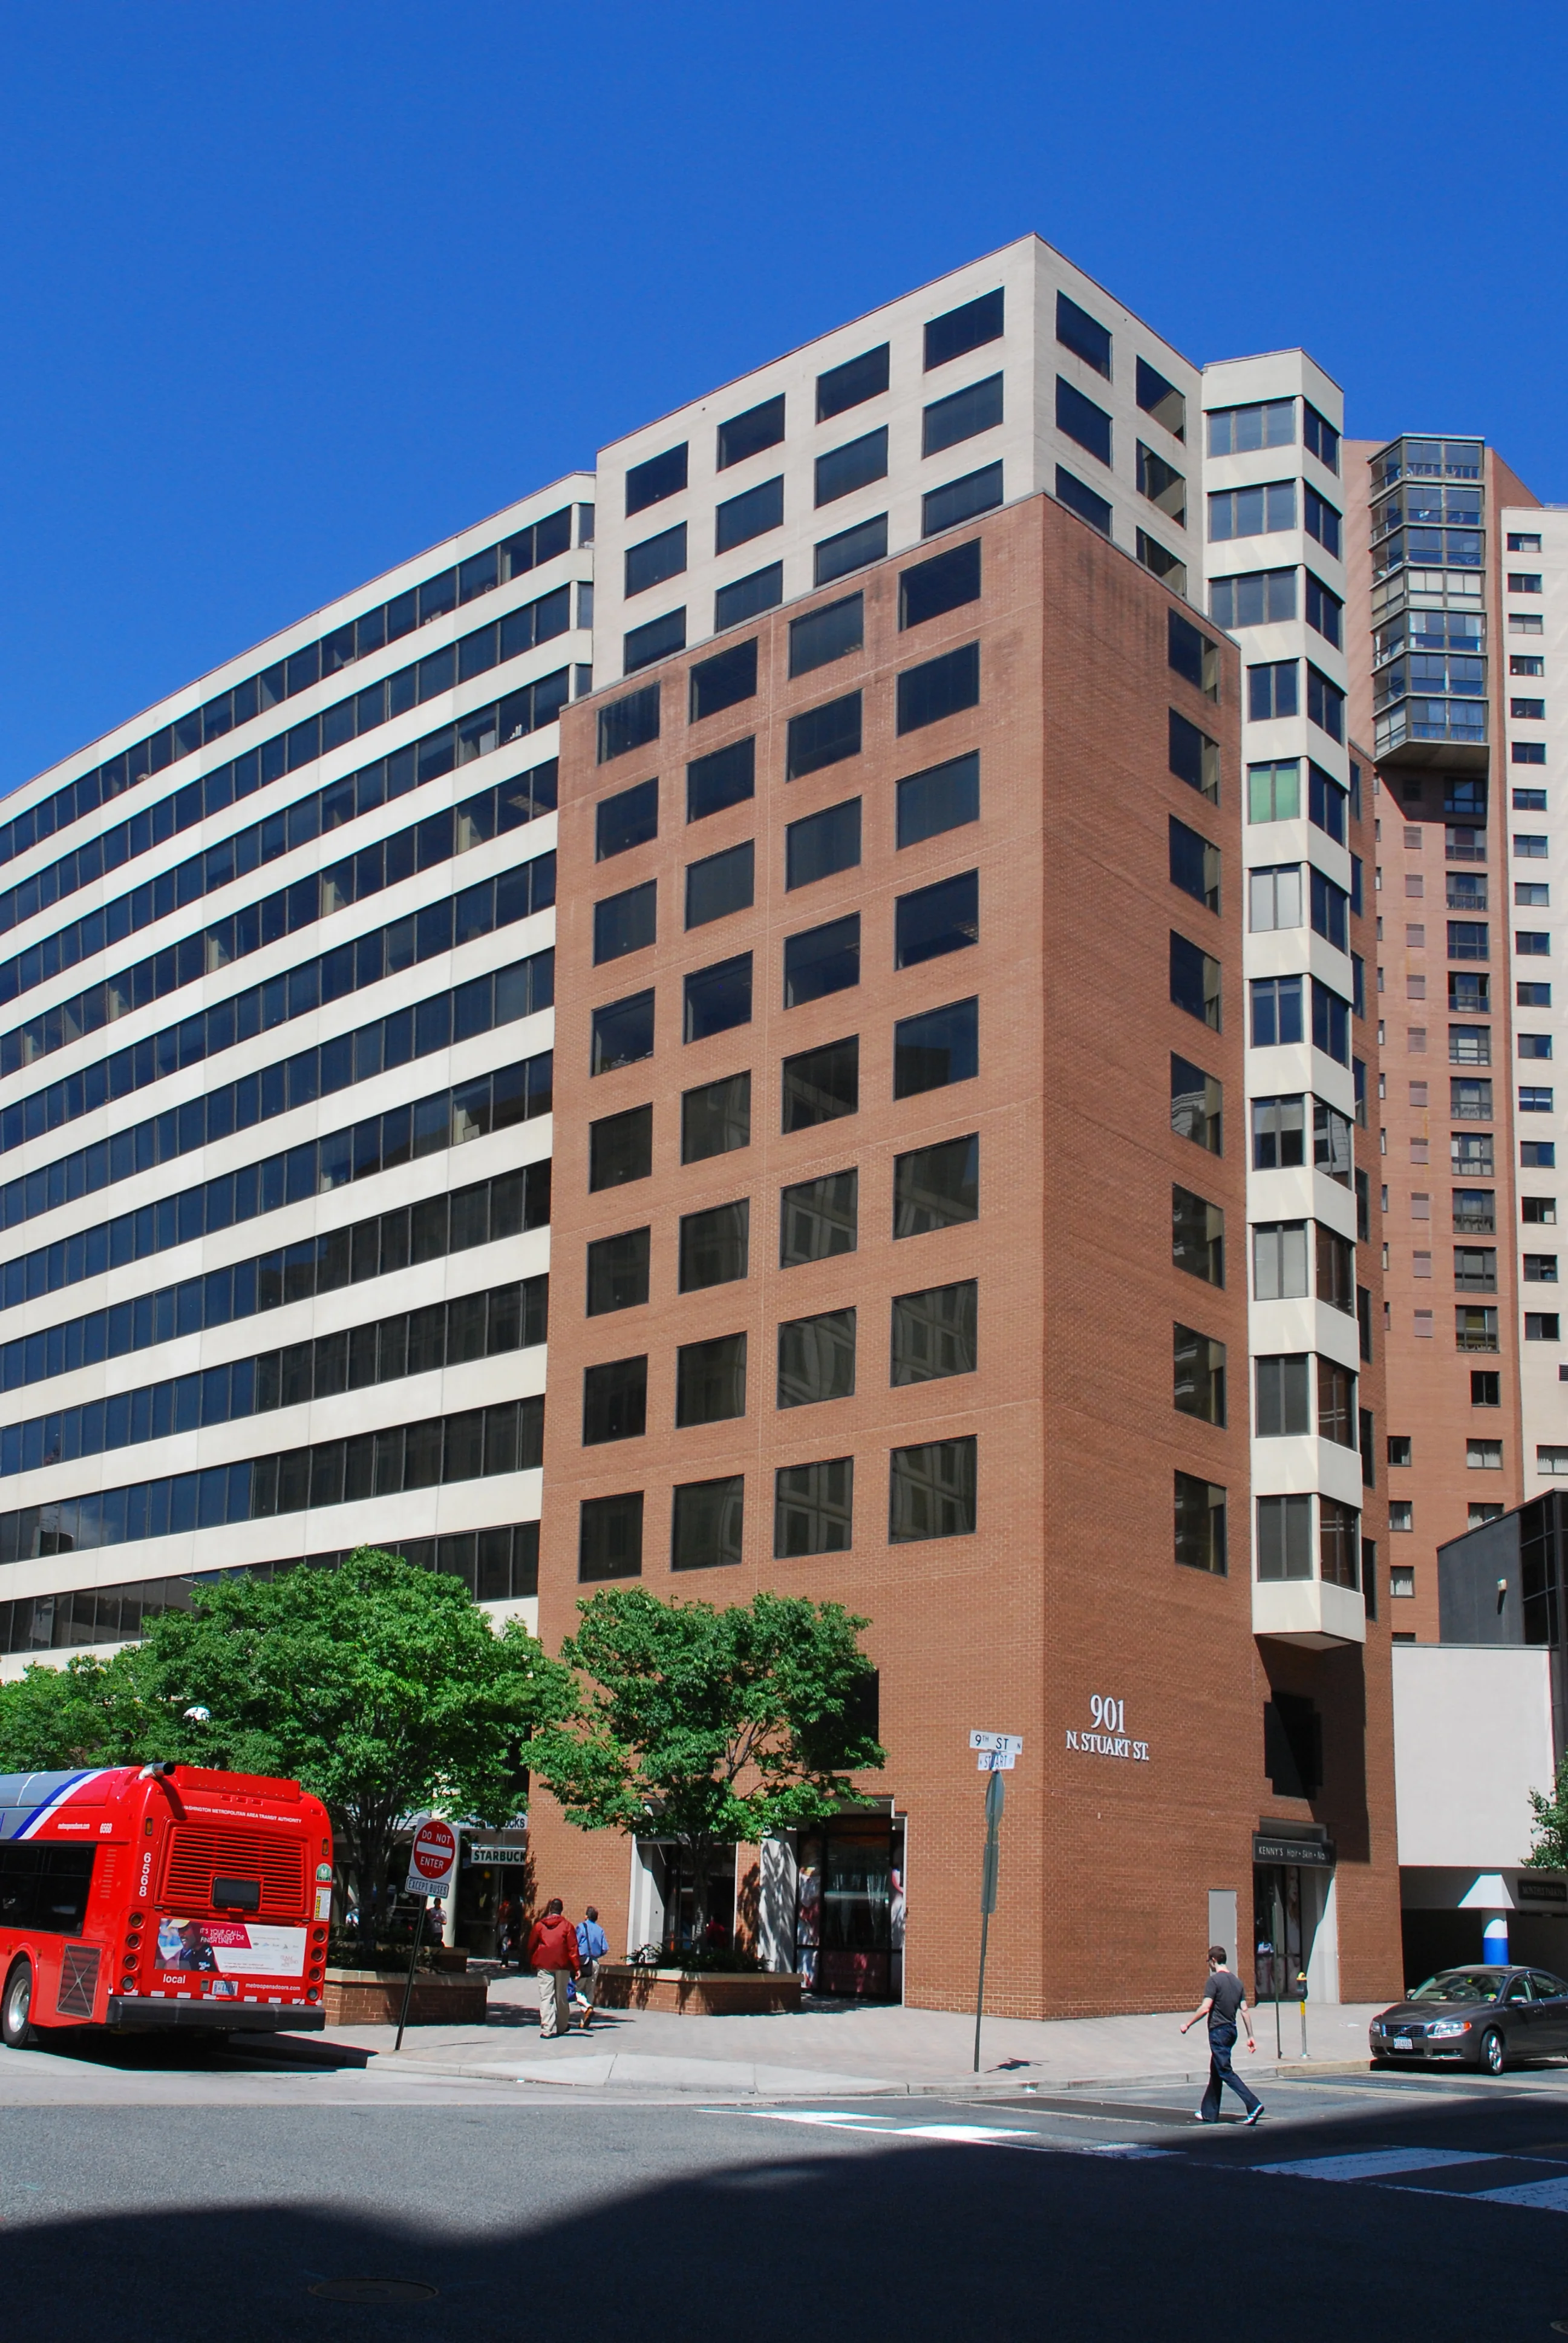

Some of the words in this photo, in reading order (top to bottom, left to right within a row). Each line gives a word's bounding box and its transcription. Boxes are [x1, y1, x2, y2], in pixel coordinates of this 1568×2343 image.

[1090, 1694, 1126, 1733] 901
[975, 1734, 989, 1746] 9TH
[996, 1737, 1009, 1750] ST
[1081, 1732, 1131, 1758] STUART
[1133, 1742, 1149, 1761] ST.
[212, 1808, 246, 1817] METROPOLITAN
[422, 1830, 432, 1840] DO
[436, 1833, 451, 1844] NOT
[1258, 1846, 1282, 1856] KENNY'S
[1287, 1849, 1298, 1857] Hair
[1302, 1850, 1313, 1858] Skin
[420, 1856, 444, 1869] ENTER
[139, 1852, 151, 1897] 6568
[408, 1879, 428, 1892] EXCEPT
[430, 1883, 448, 1896] BUSES
[163, 1974, 186, 1984] local
[246, 1982, 301, 1991] metroopensdoors.com
